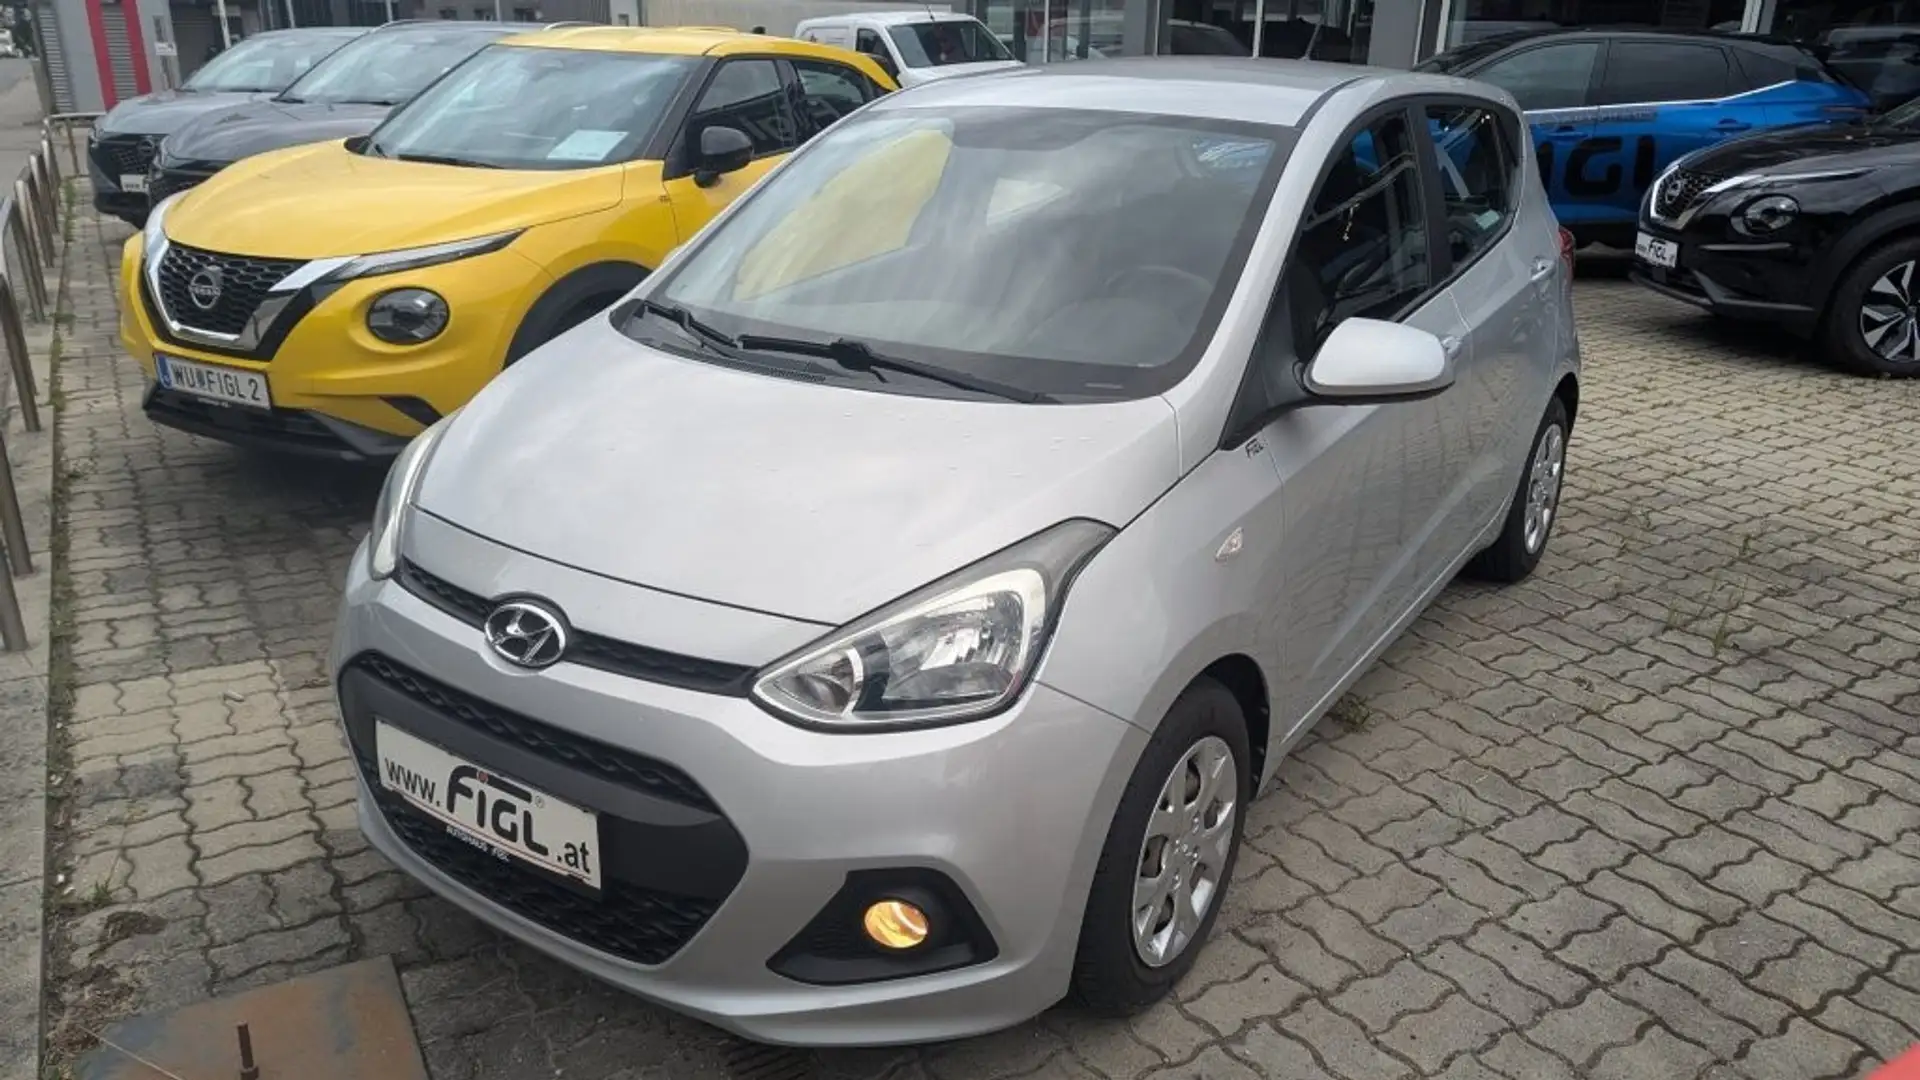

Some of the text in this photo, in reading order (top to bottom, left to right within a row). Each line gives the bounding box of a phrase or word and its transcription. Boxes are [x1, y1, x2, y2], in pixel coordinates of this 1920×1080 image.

[171, 364, 262, 401] WU FIGL 2
